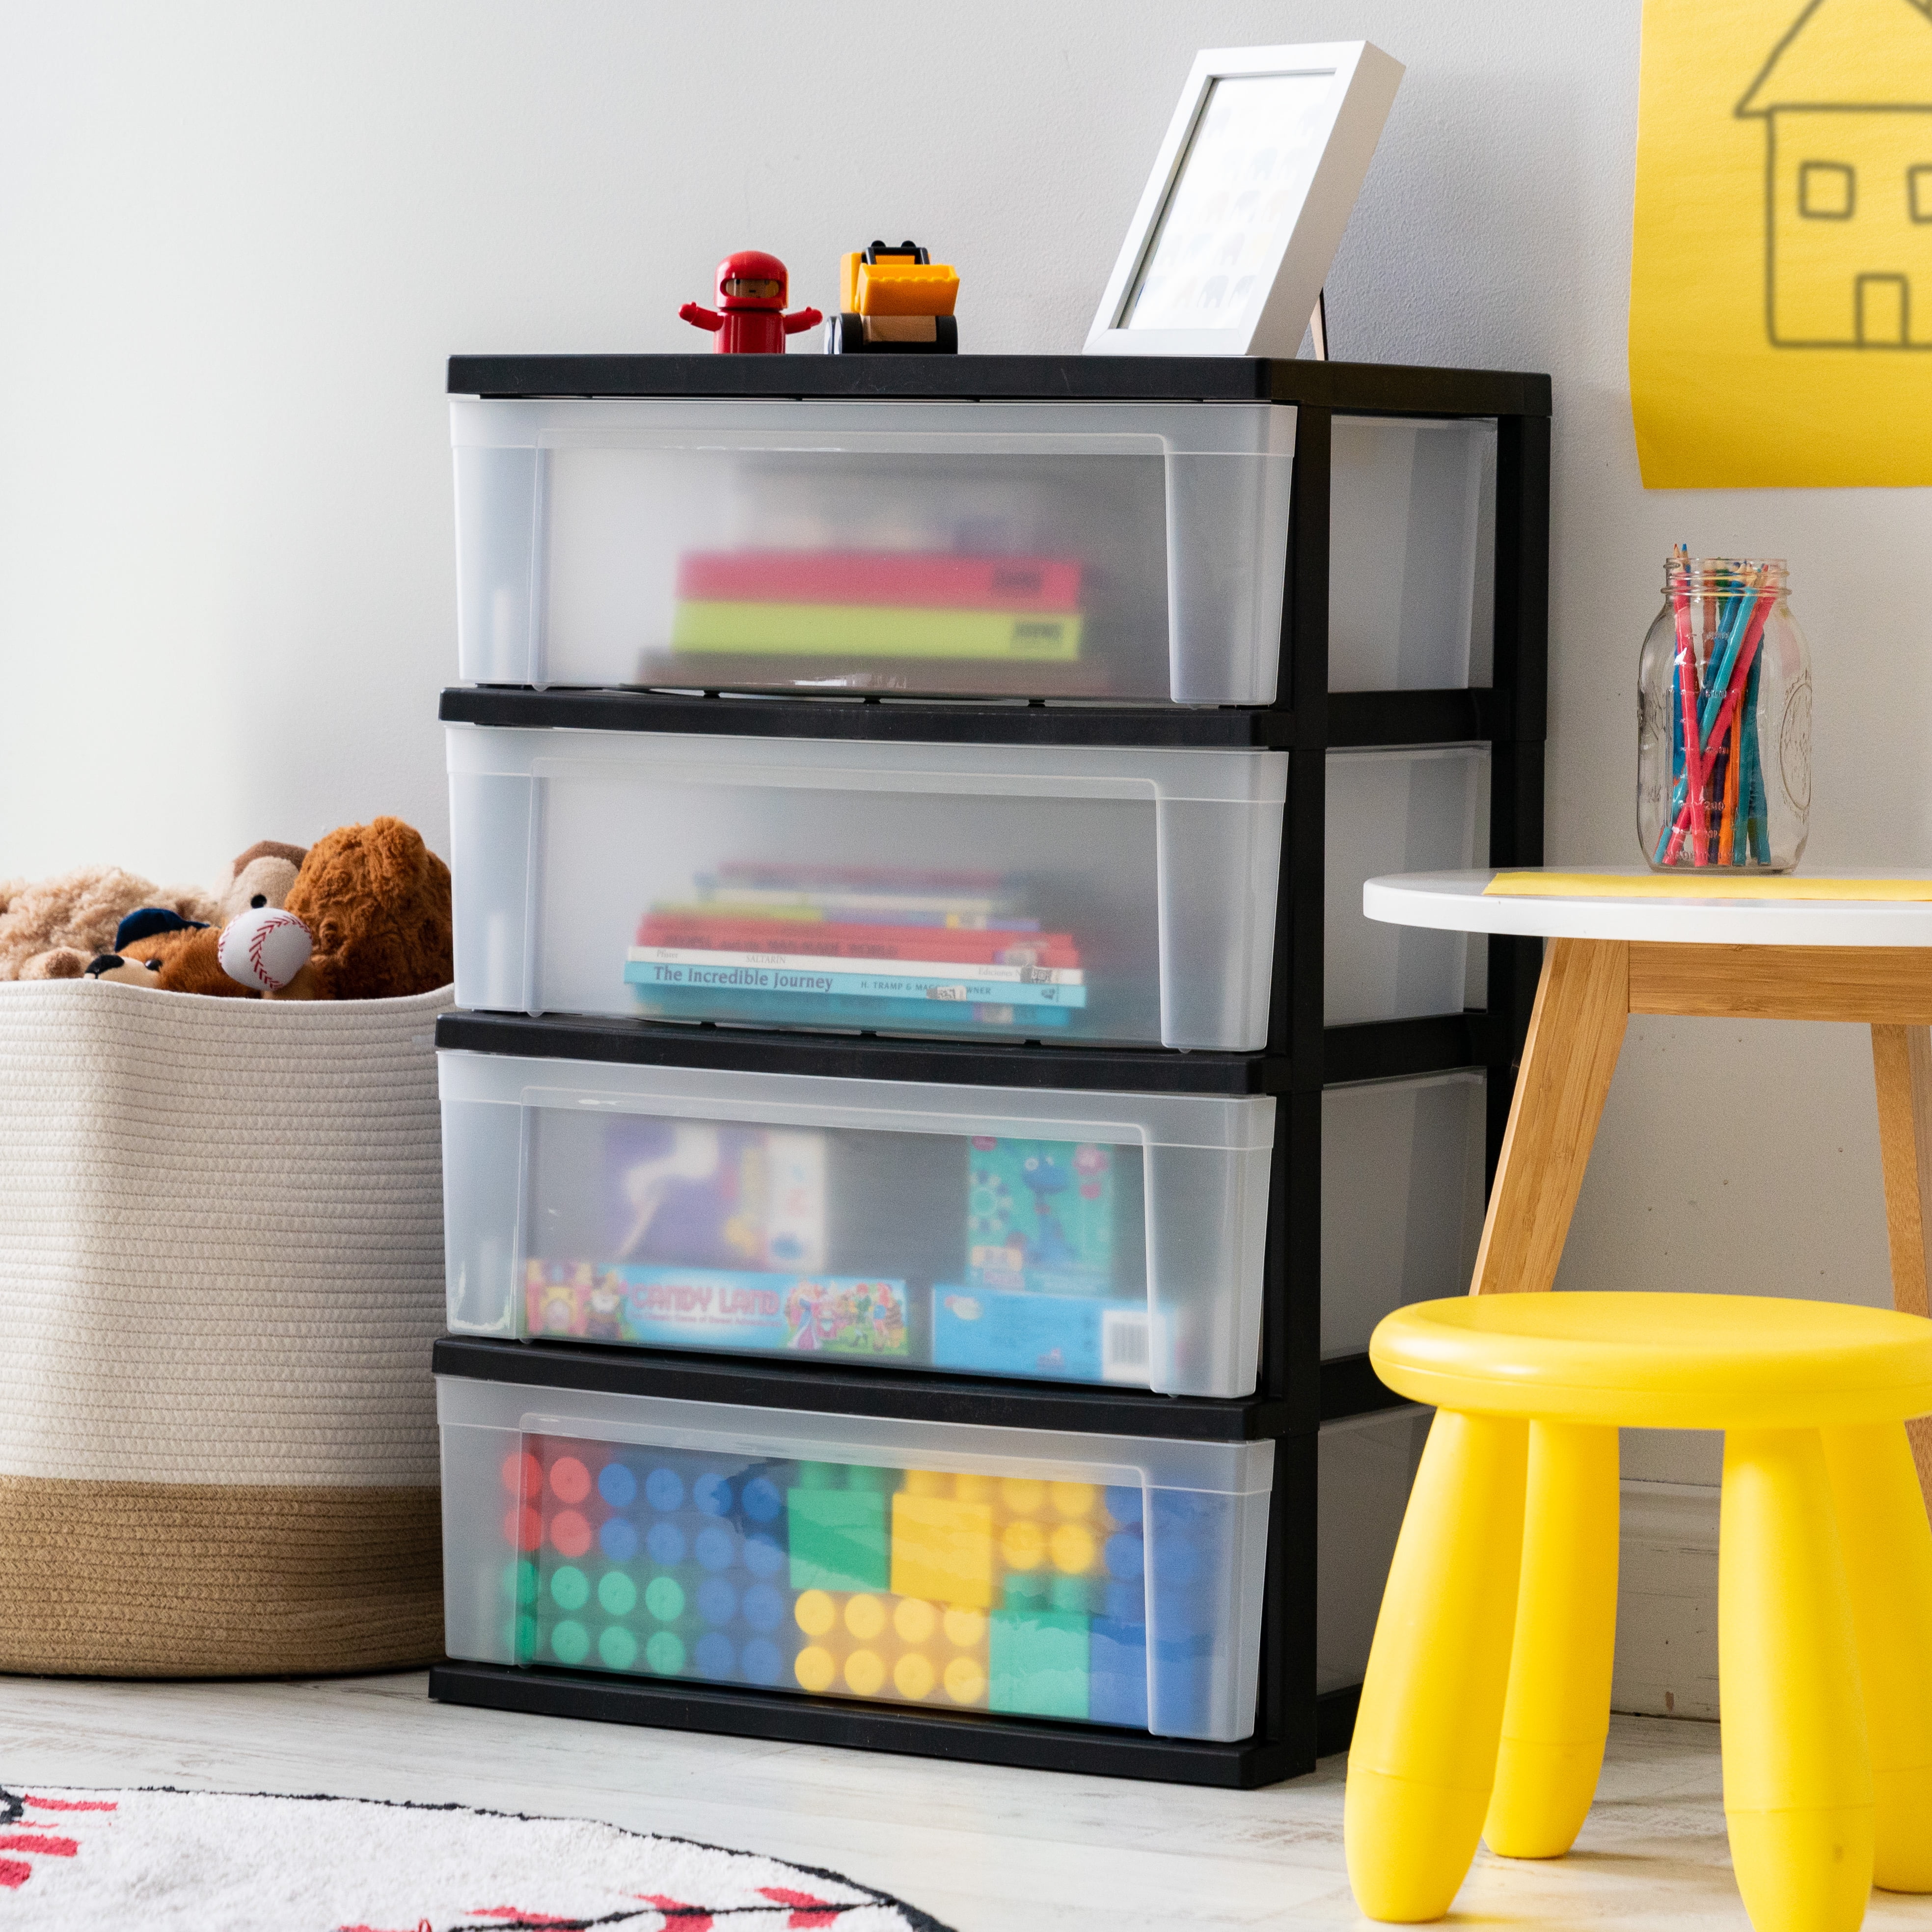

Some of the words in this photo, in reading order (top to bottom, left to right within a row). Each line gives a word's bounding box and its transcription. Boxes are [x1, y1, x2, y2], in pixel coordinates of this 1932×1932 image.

[656, 949, 678, 959] Pfister
[653, 966, 683, 981] The
[688, 968, 768, 986] Incredible
[773, 972, 834, 993] Journey
[632, 1283, 712, 1312] CANDY
[718, 1288, 780, 1317] LAND
